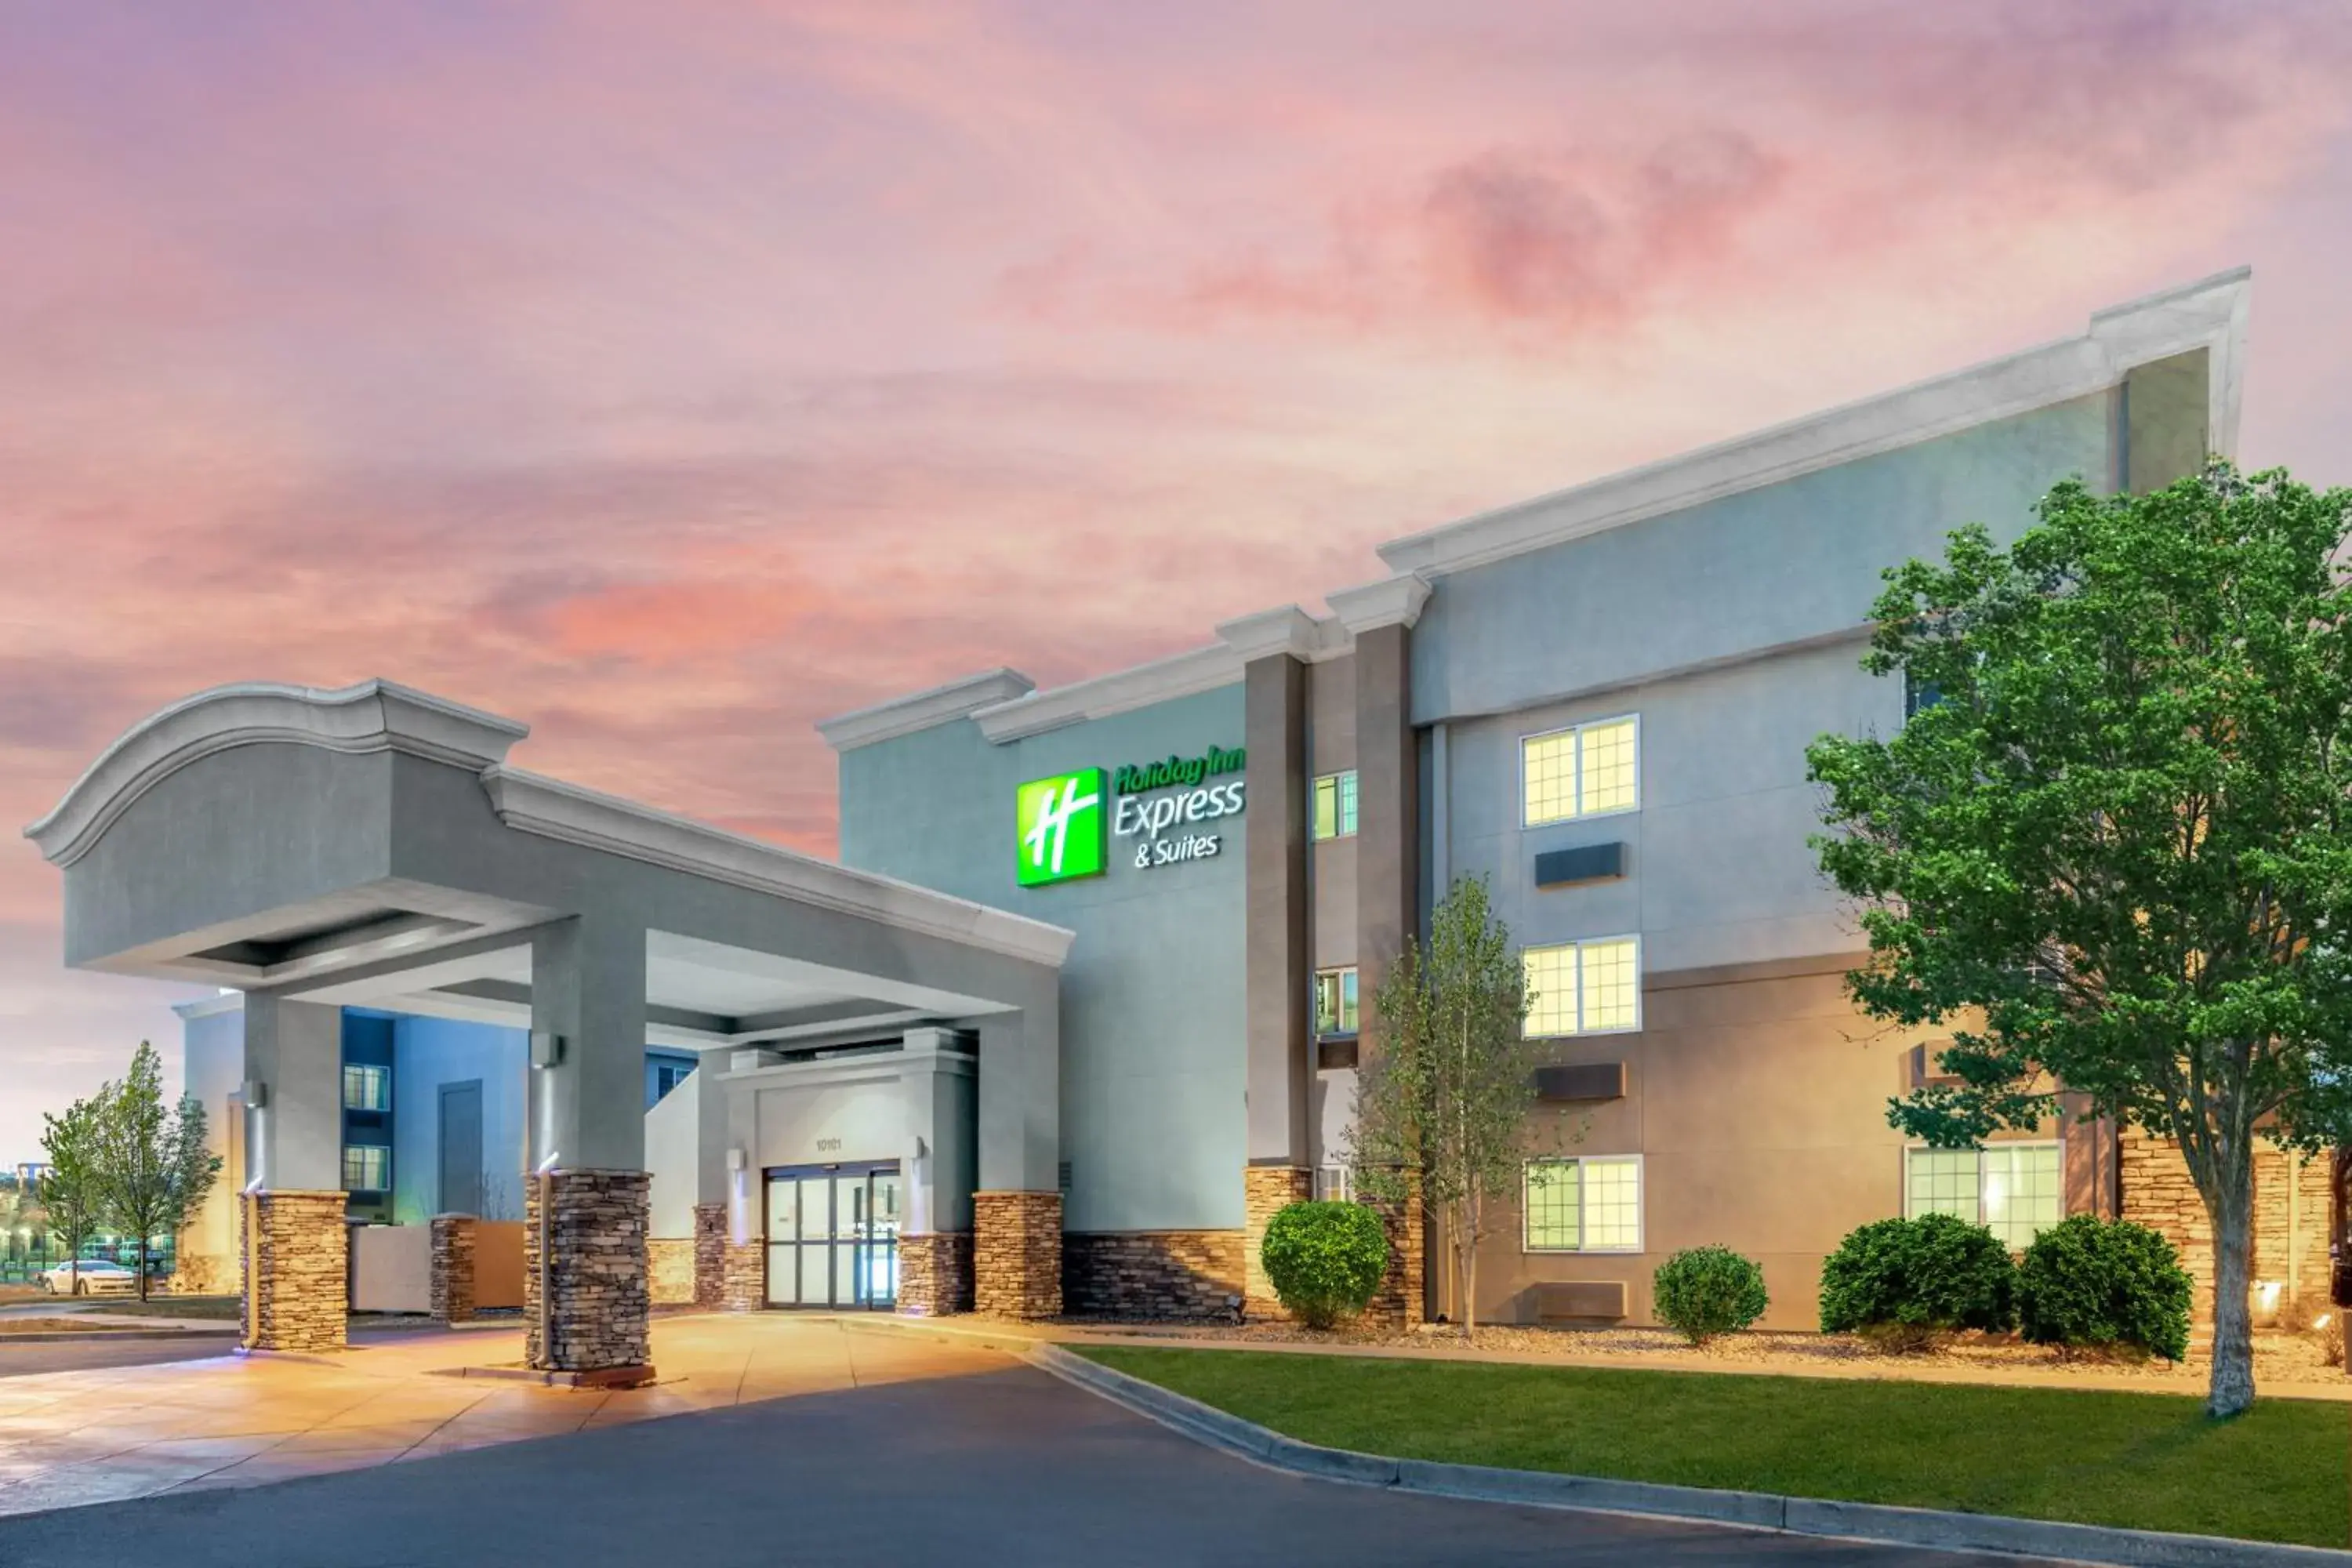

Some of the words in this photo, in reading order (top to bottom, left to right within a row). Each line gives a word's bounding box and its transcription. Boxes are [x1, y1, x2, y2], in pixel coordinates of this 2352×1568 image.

[1114, 754, 1206, 795] Holiday
[1207, 744, 1246, 775] Inn
[1115, 782, 1244, 839] Express
[1135, 844, 1150, 868] &
[1154, 835, 1218, 865] Suites
